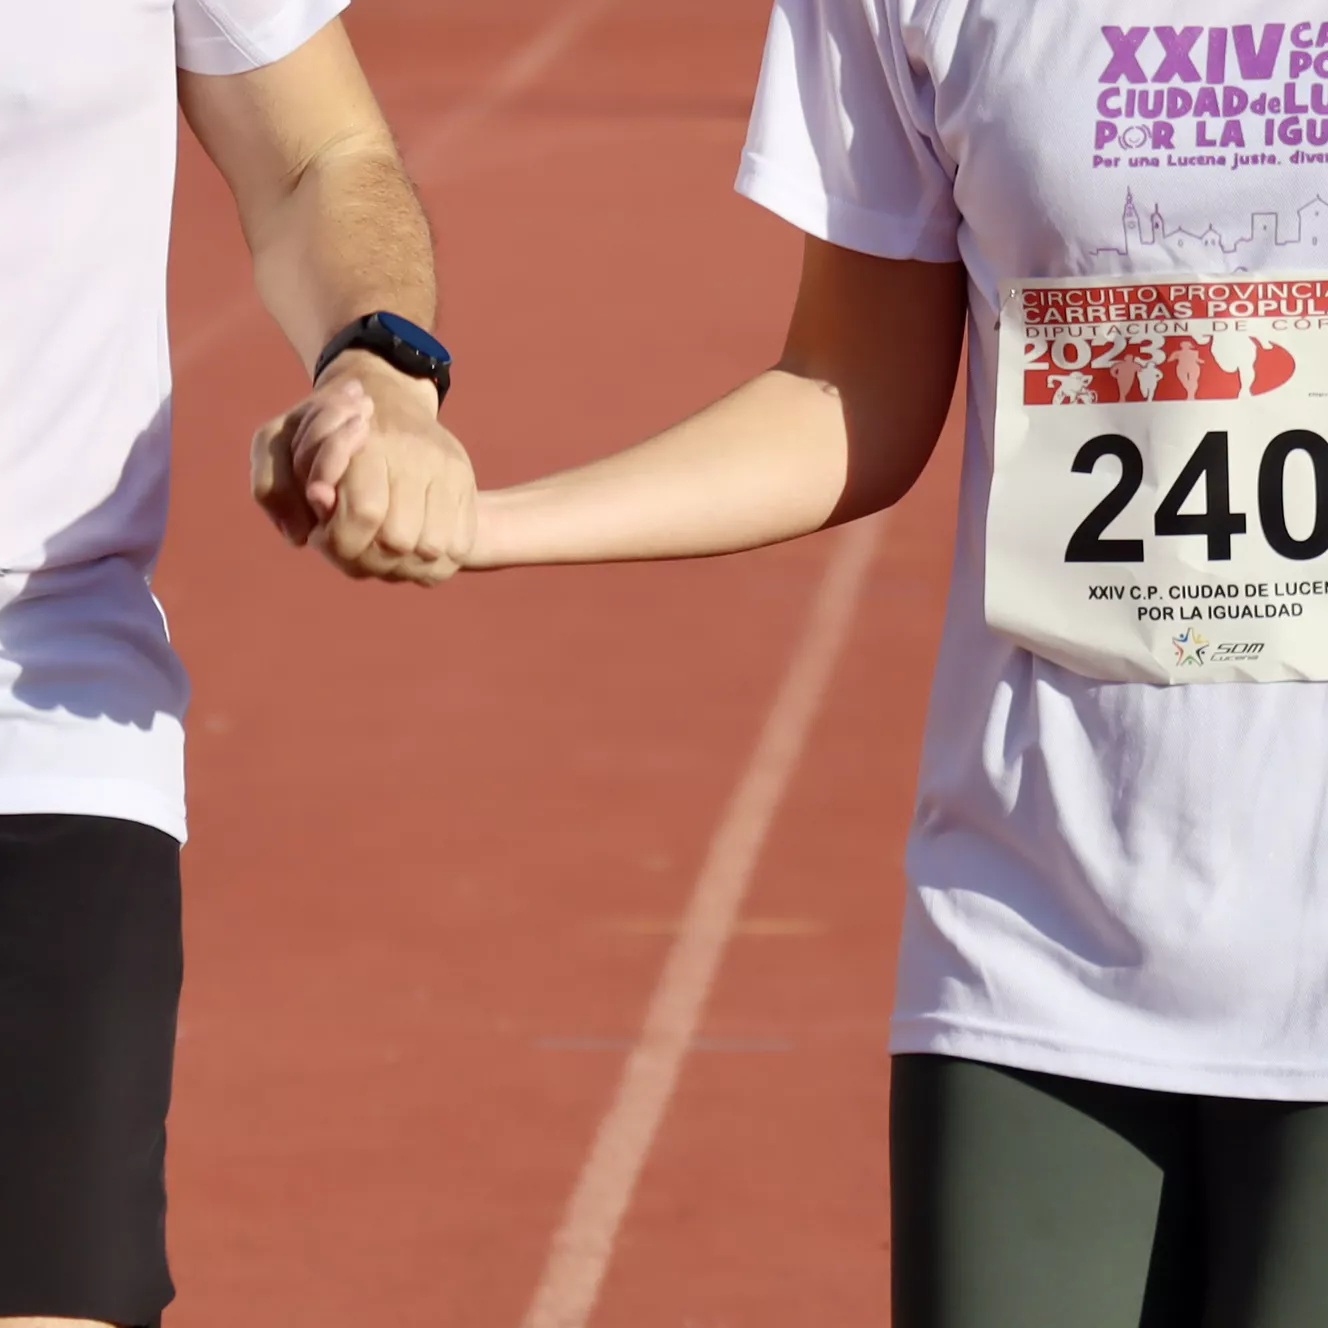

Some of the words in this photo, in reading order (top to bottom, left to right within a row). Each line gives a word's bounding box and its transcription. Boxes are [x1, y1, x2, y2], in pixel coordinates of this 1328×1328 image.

[1098, 23, 1286, 84] XXIV
[1097, 85, 1249, 118] CIUDAD
[1094, 120, 1175, 150] POR
[1196, 120, 1246, 148] LA
[1092, 154, 1120, 168] Por
[1128, 156, 1159, 167] una
[1167, 154, 1226, 166] Lucena
[1023, 286, 1158, 307] CIRCUITO
[1024, 301, 1193, 323] CARRERAS
[1025, 320, 1189, 339] DIPUTACIÓN
[1212, 320, 1249, 332] DE
[1023, 336, 1166, 371] 2023
[1088, 585, 1125, 600] XXIV
[1129, 586, 1163, 600] C.P.
[1168, 584, 1239, 599] CIUDAD
[1245, 583, 1269, 598] DE
[1137, 607, 1174, 621] POR
[1179, 606, 1203, 620] LA
[1208, 603, 1304, 620] IGUALDAD
